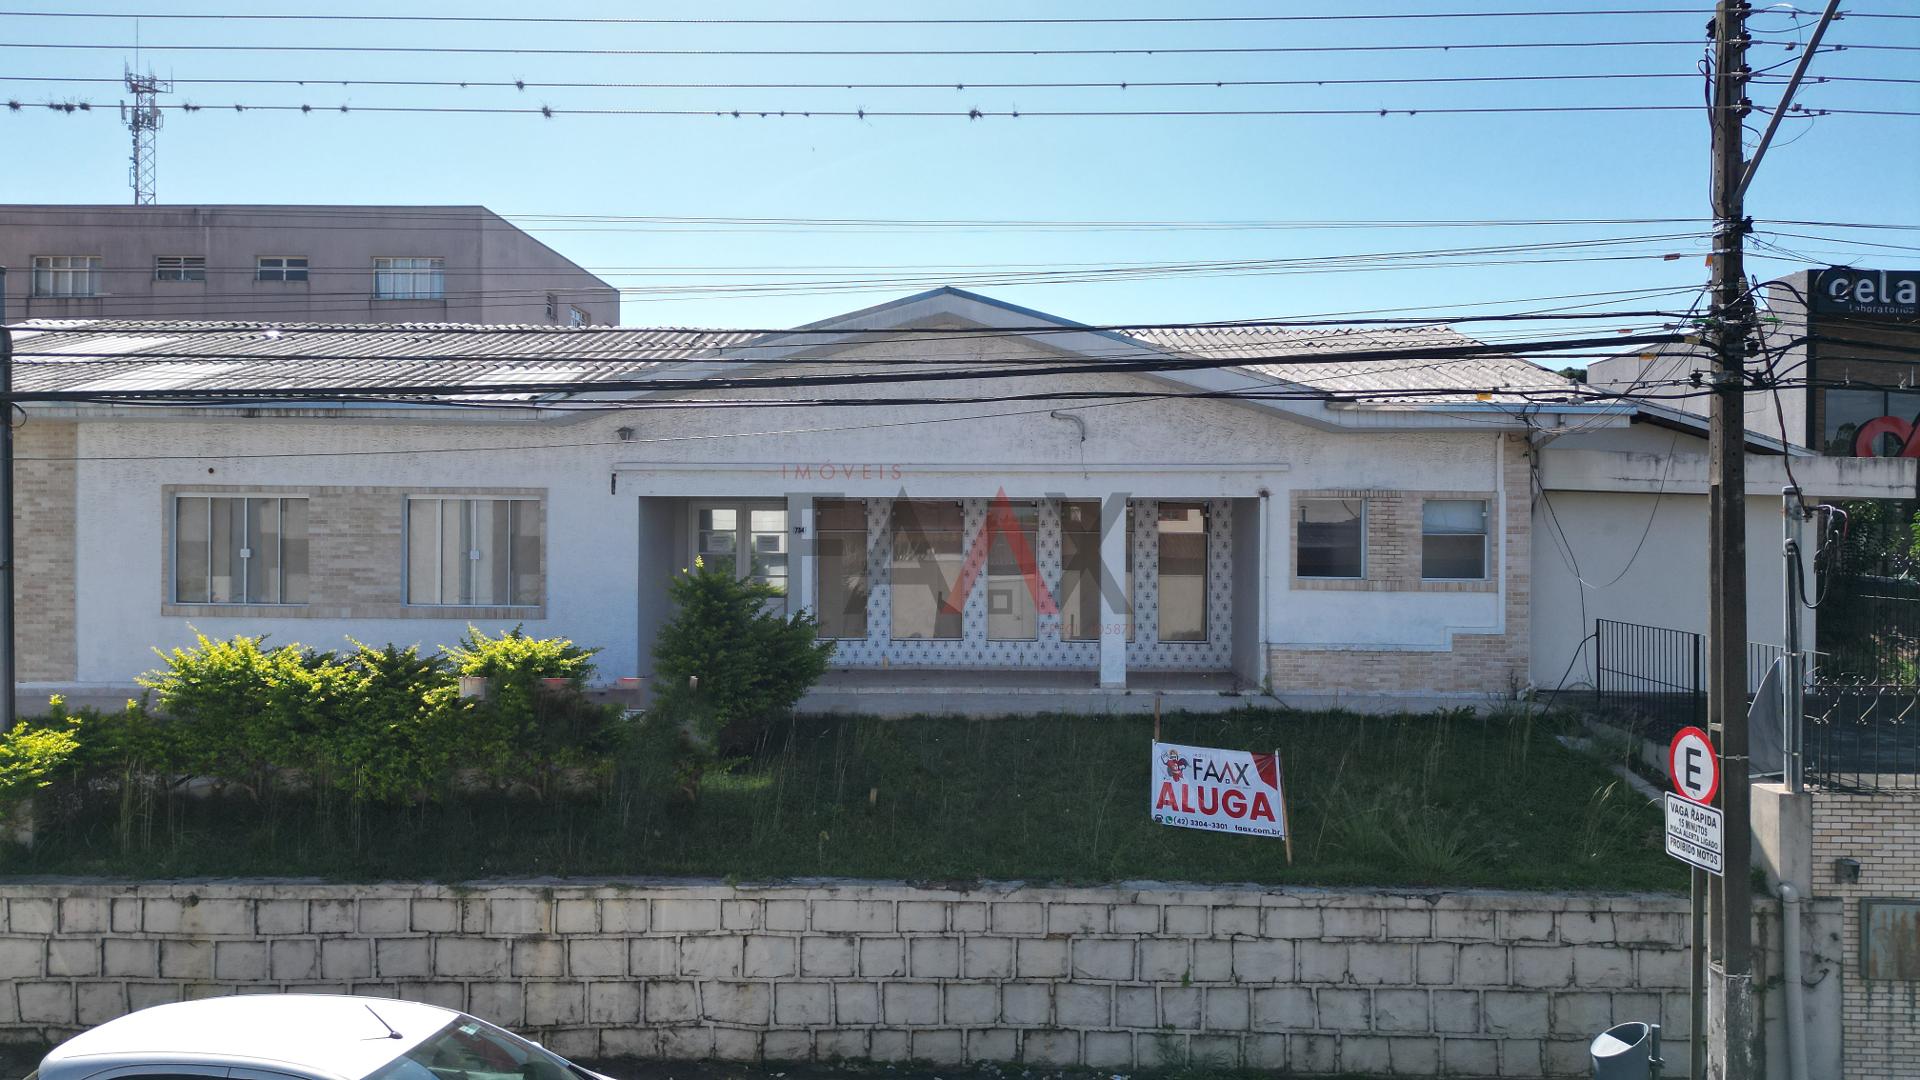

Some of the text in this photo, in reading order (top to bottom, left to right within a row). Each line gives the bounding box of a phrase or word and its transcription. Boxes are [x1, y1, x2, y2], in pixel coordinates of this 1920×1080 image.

[1686, 747, 1701, 791] E
[1156, 782, 1276, 822] ALUGA
[1671, 802, 1689, 818] VAGA
[1173, 816, 1280, 835] (42) 3304-3301 faax.com.br
[1686, 820, 1708, 836] MINUTOS
[1670, 837, 1718, 865] PROIBIDO MOTOS
